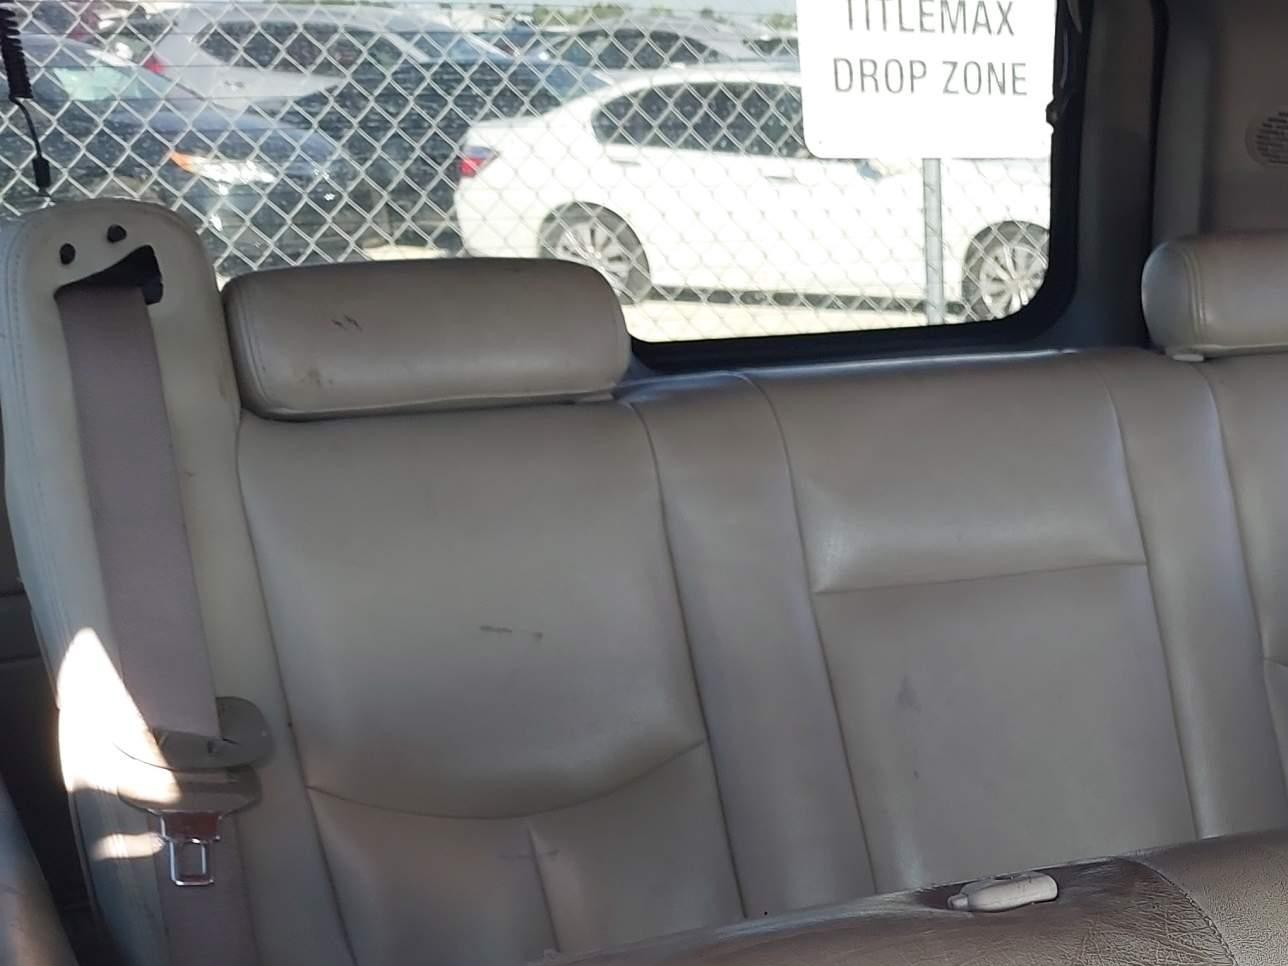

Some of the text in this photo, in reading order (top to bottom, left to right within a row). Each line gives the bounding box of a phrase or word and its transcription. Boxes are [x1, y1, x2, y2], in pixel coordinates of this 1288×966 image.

[845, 0, 1014, 36] TITLEMAX
[833, 57, 1028, 95] DROP ZONE
